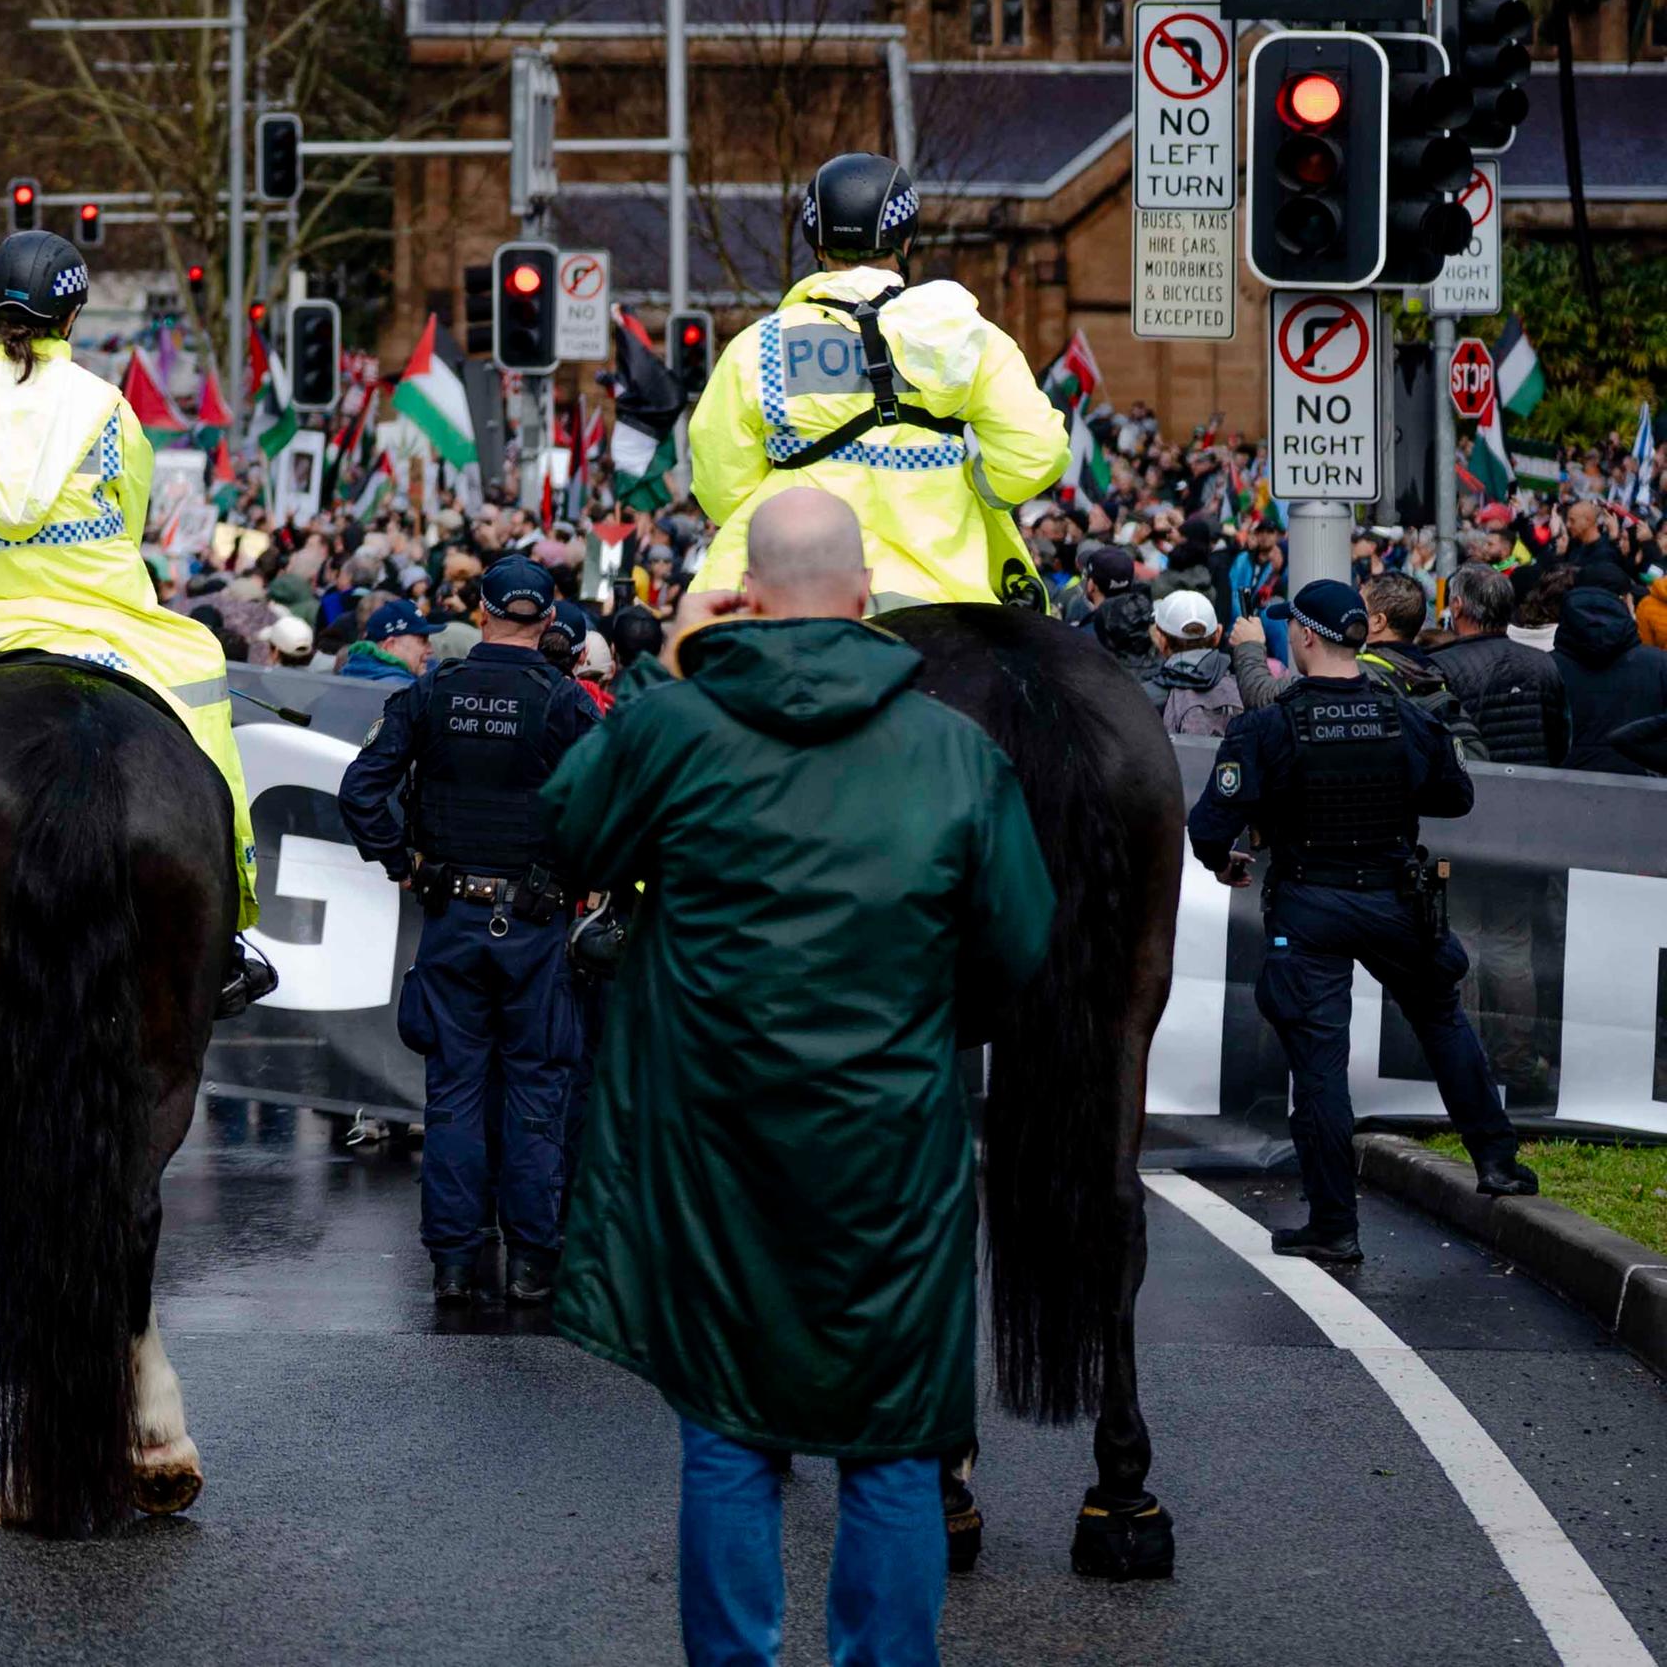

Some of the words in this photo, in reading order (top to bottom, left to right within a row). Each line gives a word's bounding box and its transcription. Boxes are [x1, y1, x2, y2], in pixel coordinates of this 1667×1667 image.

[1160, 108, 1210, 135] NO
[1150, 144, 1219, 164] LEFT
[1147, 175, 1223, 197] TURN
[1141, 213, 1185, 231] BUSES,
[1192, 213, 1228, 230] TAXIS
[1149, 237, 1176, 254] HIRE
[1458, 236, 1483, 258] O
[1145, 261, 1224, 278] MOTORBIKES
[1145, 285, 1156, 300] &
[1163, 285, 1223, 302] BICYCLES
[1442, 287, 1490, 302] TURN
[569, 305, 596, 321] NO
[1144, 309, 1224, 326] EXCEPTED
[1452, 362, 1490, 393] STOP
[1297, 395, 1351, 424] NO
[1284, 435, 1365, 455] RIGHT
[1287, 465, 1362, 486] TURN
[451, 696, 519, 714] POLICE
[1313, 703, 1379, 720] POLICE
[449, 716, 478, 733] CMR
[485, 719, 517, 736] ODIN
[1315, 725, 1345, 739] CMR
[1351, 723, 1382, 737] ODIN
